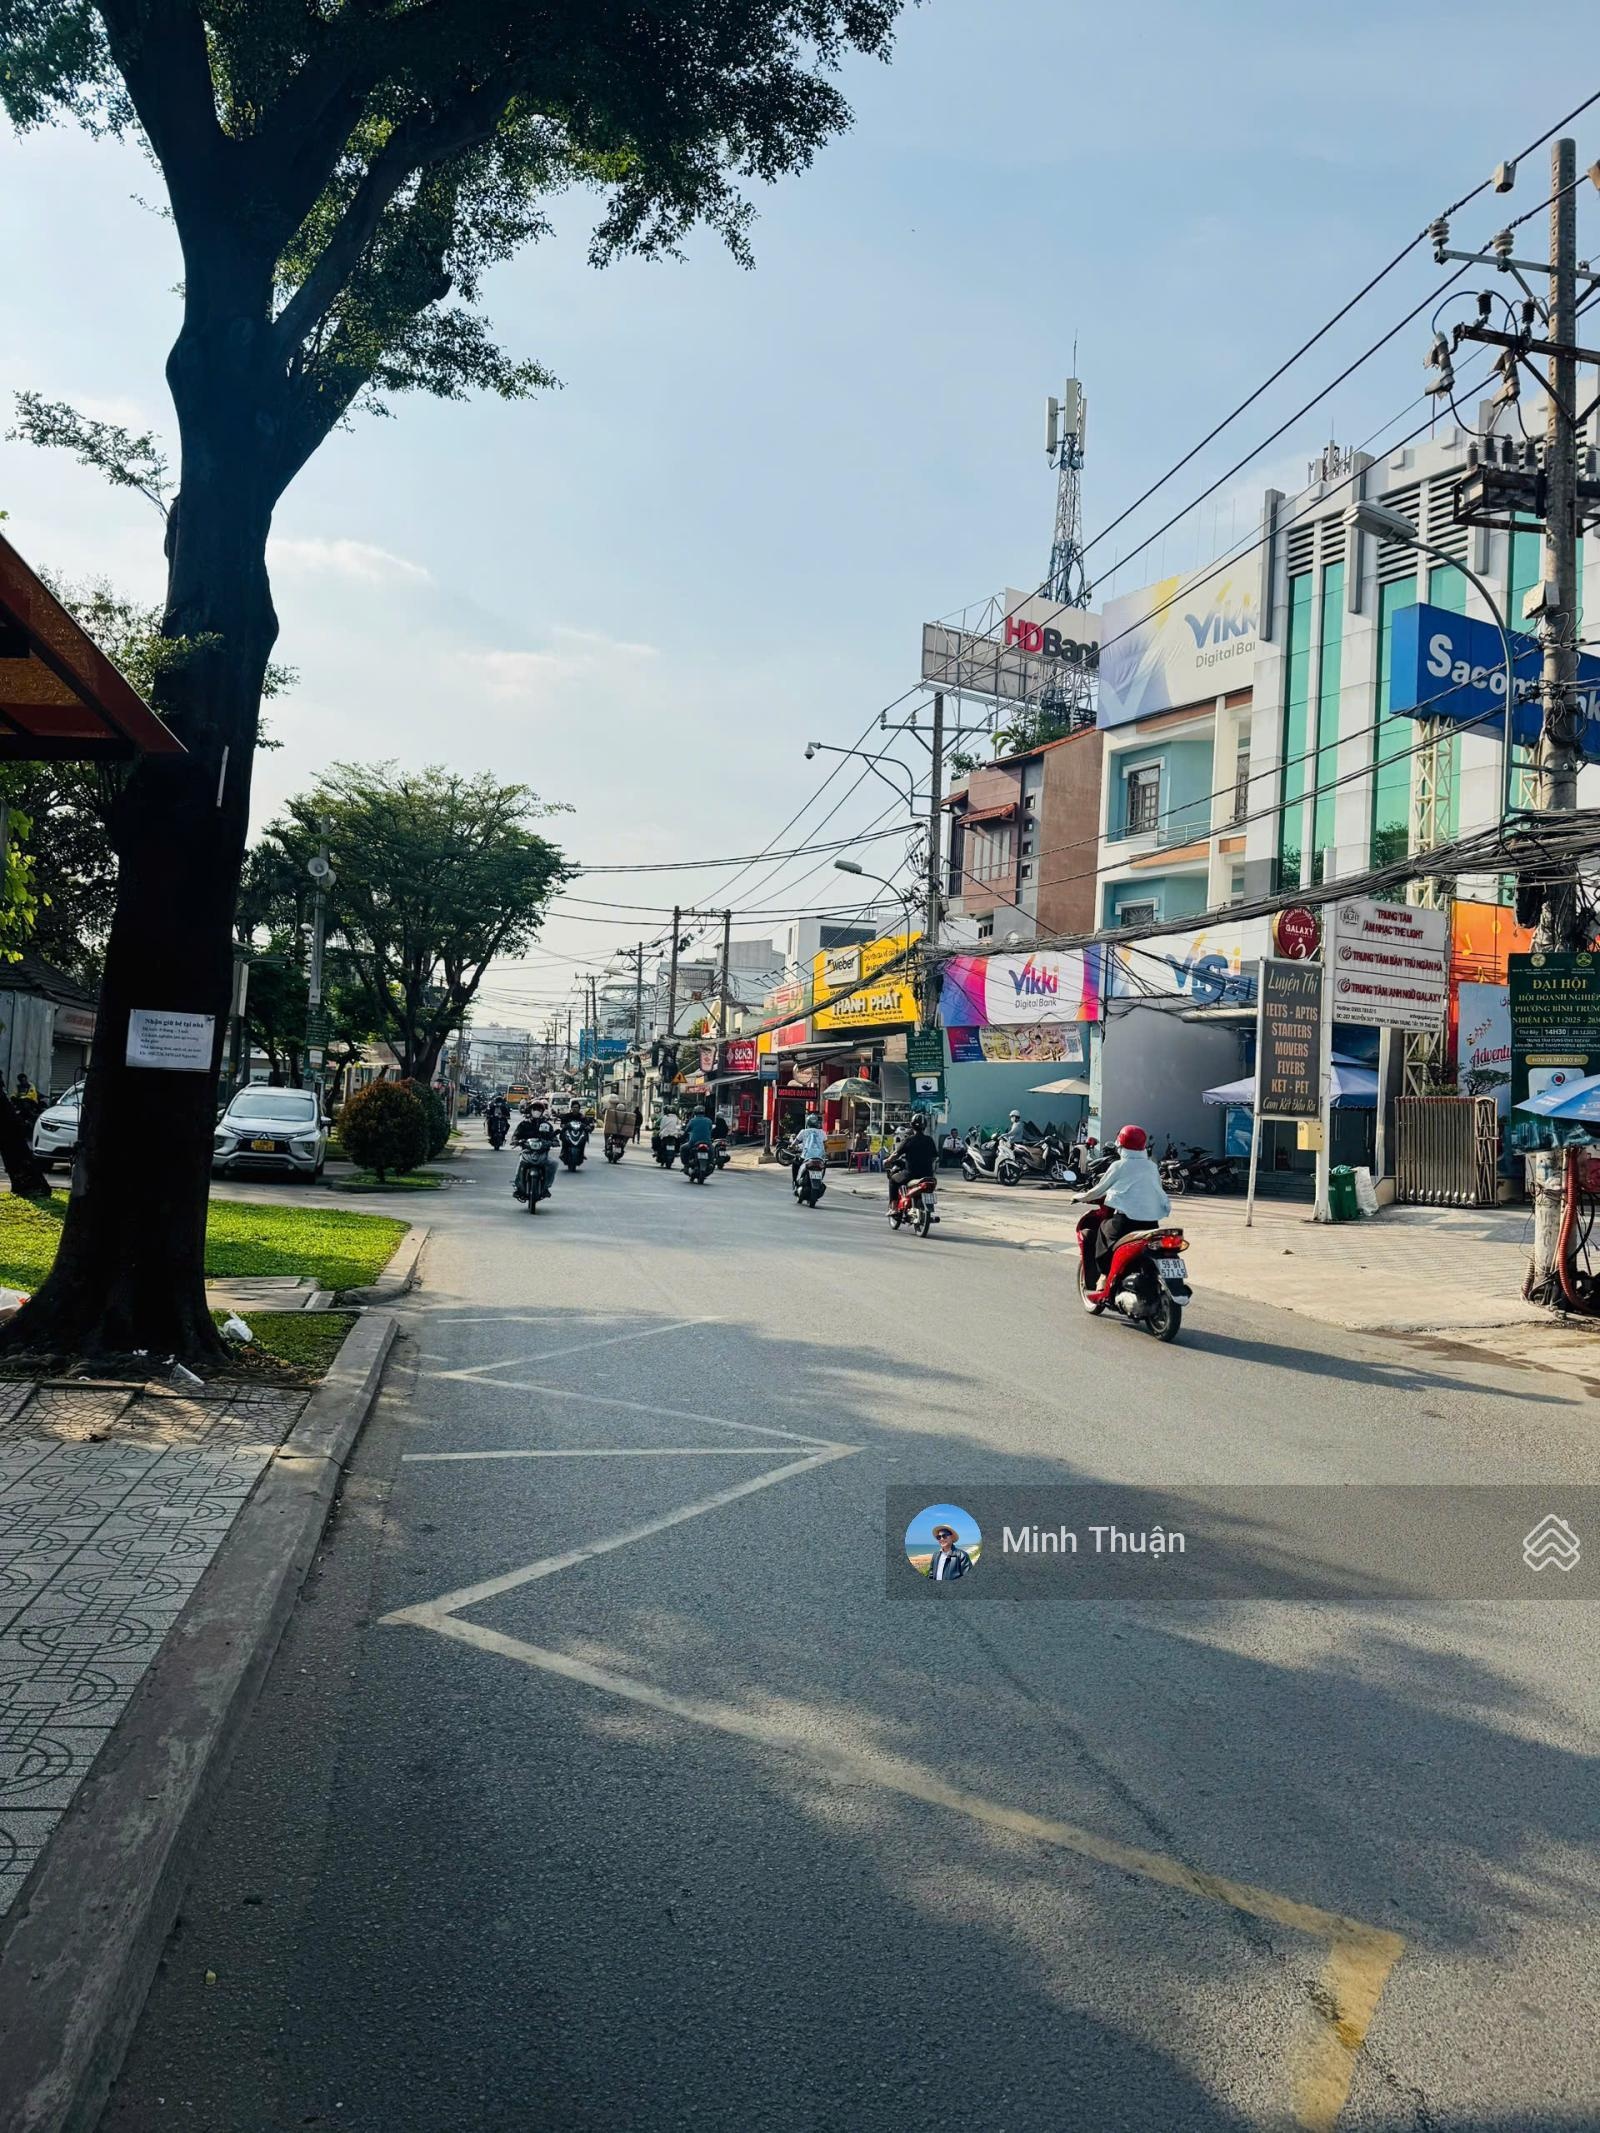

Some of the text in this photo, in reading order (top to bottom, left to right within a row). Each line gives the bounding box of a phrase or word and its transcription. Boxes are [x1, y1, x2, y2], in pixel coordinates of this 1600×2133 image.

[1376, 908, 1413, 924] TRUNG TÂM
[1285, 924, 1314, 936] GALAXY
[1394, 926, 1406, 937] THE
[1406, 929, 1424, 940] LIGHT
[833, 957, 855, 970] weber
[1352, 950, 1374, 963] TRUNG
[1375, 952, 1389, 965] TÂM
[1008, 954, 1059, 996] Vikki
[1268, 968, 1319, 997] Luyện Thi
[1533, 977, 1587, 991] ĐẠI HỘI
[1351, 982, 1373, 995] TRUNG
[1374, 984, 1388, 997] TÂM
[1388, 987, 1402, 998] ANH
[1416, 991, 1442, 1003] GALAXY
[1015, 997, 1057, 1009] Digital Bank
[1266, 1003, 1288, 1018] IELTS
[1295, 1006, 1318, 1021] APTIS
[1271, 1022, 1312, 1039] STARTERS
[1274, 1041, 1309, 1057] MOVERS
[1277, 1060, 1305, 1076] FLYERS
[1271, 1079, 1287, 1093] KET
[1295, 1080, 1309, 1094] PET
[1263, 1096, 1316, 1111] Cam Kết Đầu Ra
